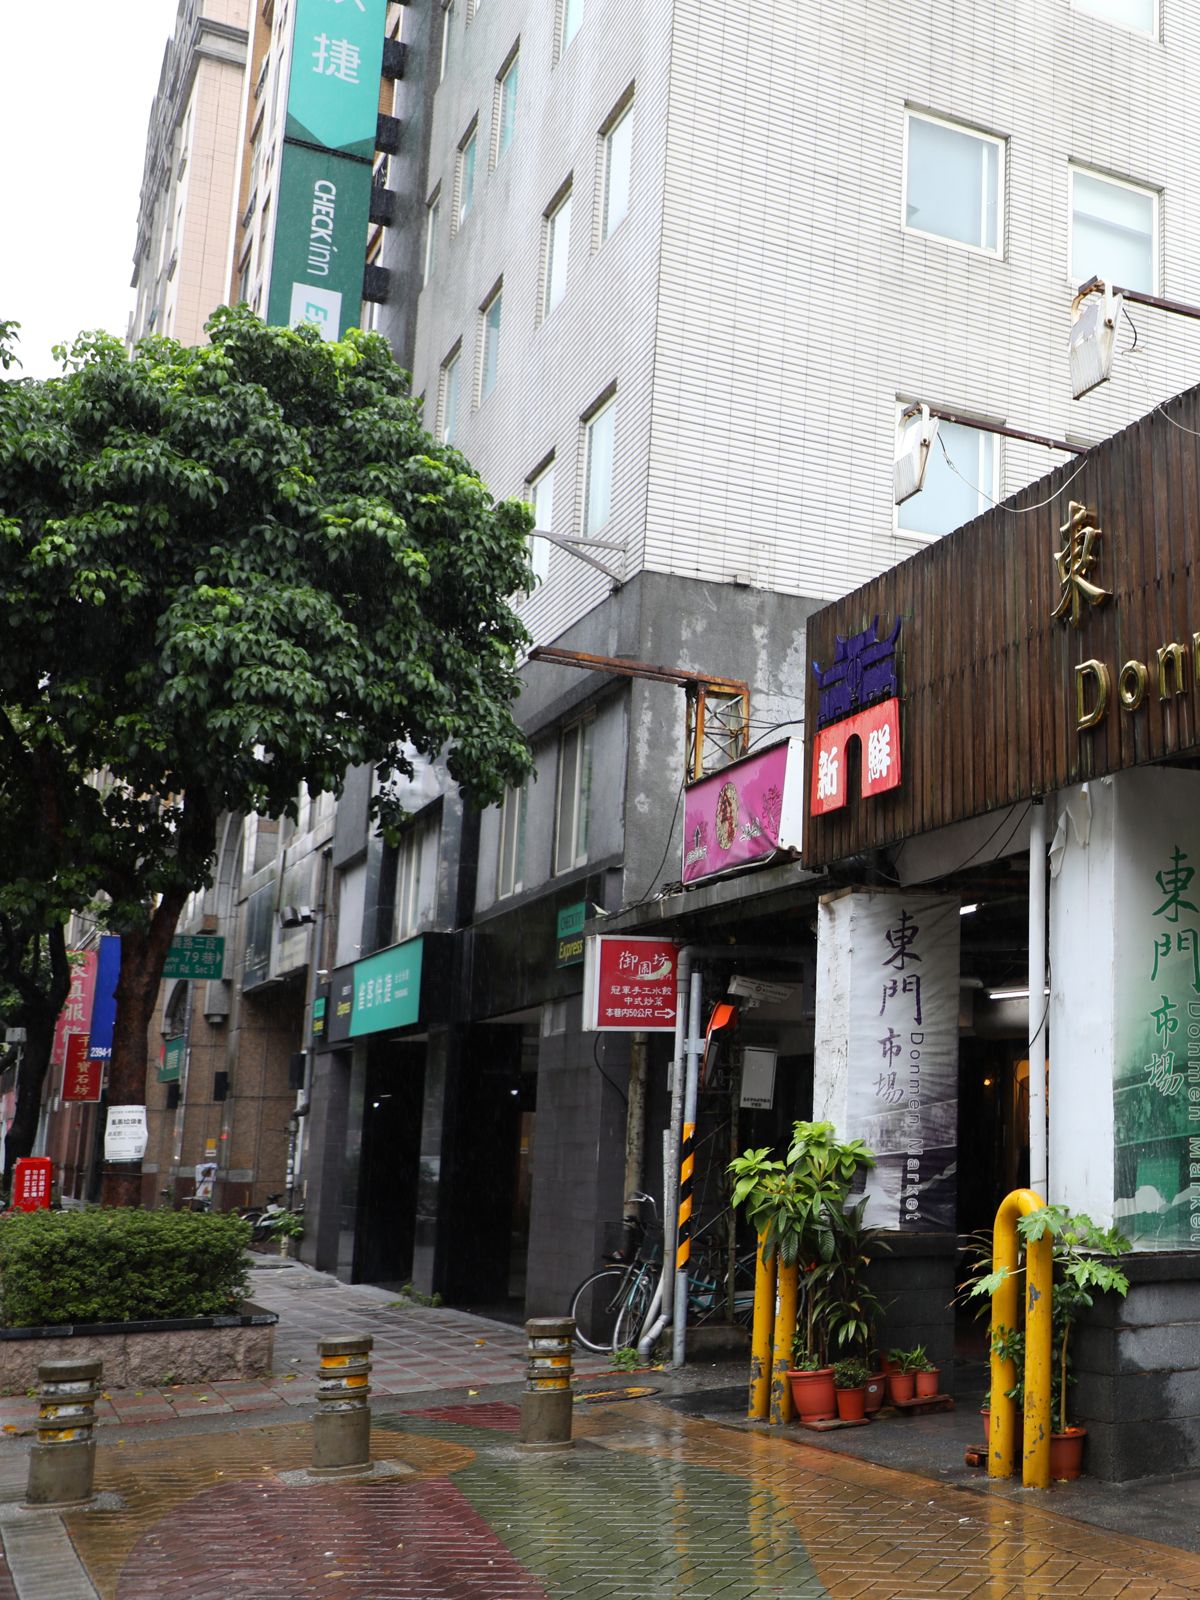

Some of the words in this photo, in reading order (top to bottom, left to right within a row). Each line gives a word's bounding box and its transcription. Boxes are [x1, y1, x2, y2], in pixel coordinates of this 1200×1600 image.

[817, 724, 891, 800] 新鮮
[611, 985, 672, 996] 冠軍手工水餃
[624, 997, 664, 1006] 中式炒菜
[873, 909, 922, 1105] 東門市場
[907, 1032, 925, 1125] Donmen
[905, 1138, 924, 1222] Market
